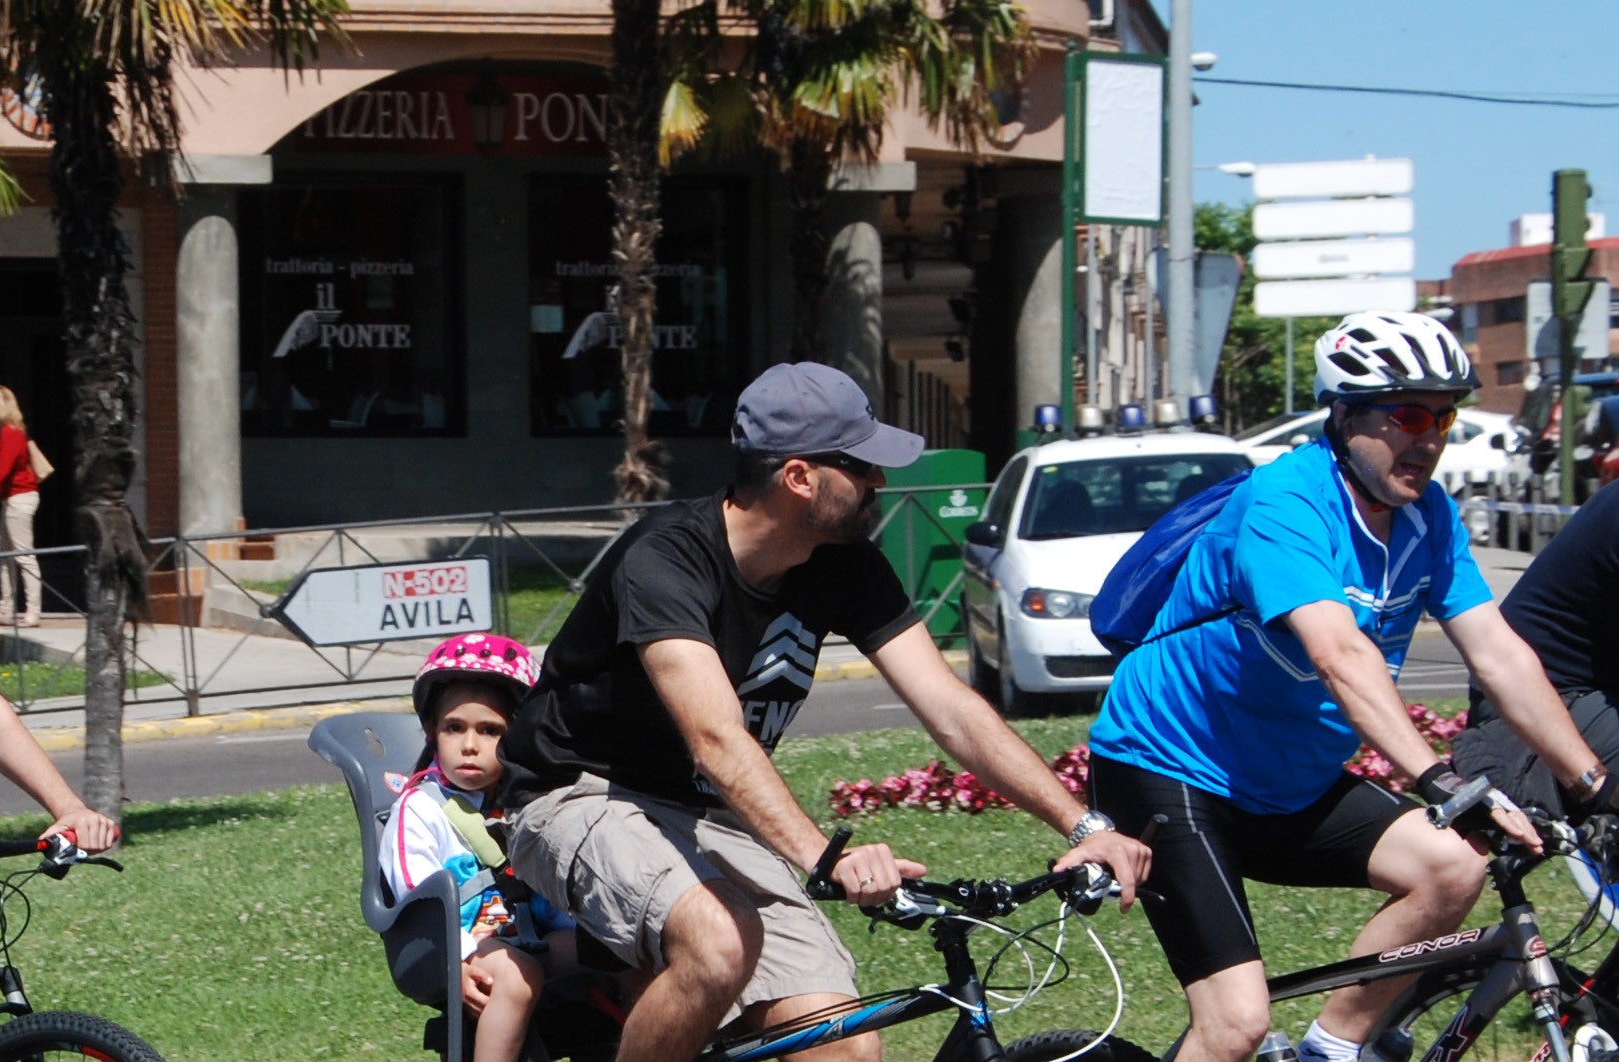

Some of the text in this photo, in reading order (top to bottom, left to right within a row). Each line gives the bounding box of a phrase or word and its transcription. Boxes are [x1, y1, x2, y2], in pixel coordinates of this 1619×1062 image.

[513, 92, 608, 142] PON
[319, 323, 411, 348] PONTE
[383, 568, 466, 598] N-502
[380, 598, 475, 631] AVILA
[1379, 929, 1480, 963] CONOR
